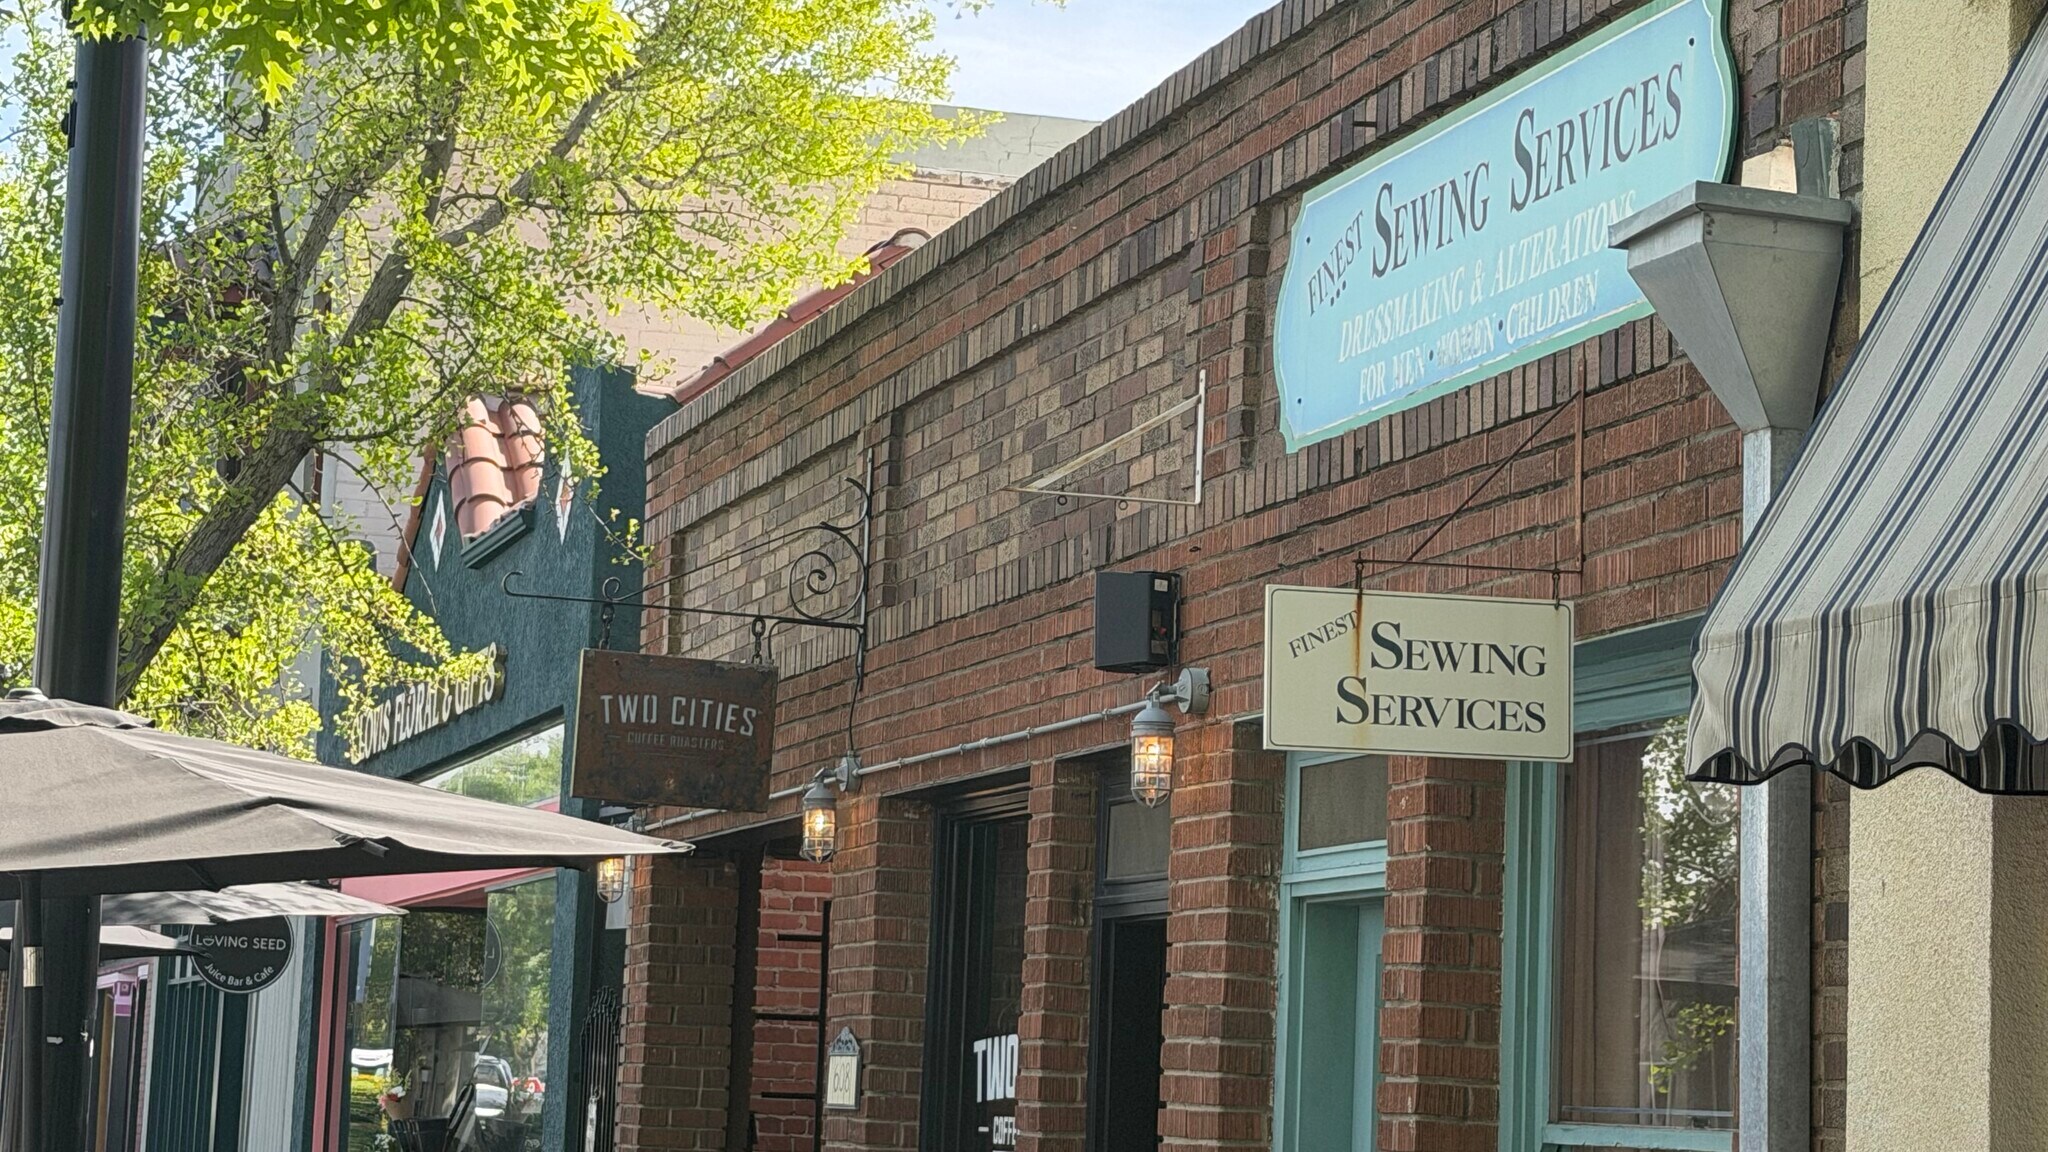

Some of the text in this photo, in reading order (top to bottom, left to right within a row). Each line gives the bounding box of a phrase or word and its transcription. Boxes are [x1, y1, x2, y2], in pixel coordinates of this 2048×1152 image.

[1371, 62, 1684, 280] SEWING SERVICES
[1306, 209, 1366, 317] FINEST
[1338, 267, 1466, 363] DRESSMAKING
[1470, 258, 1486, 305] &
[1359, 361, 1387, 405] FOR
[1391, 342, 1427, 392] MEN
[1505, 269, 1600, 345] CHILDREN
[1288, 609, 1360, 660] FINEST
[1370, 620, 1547, 678] SEWING
[393, 678, 440, 745] FLORAL
[600, 694, 757, 737] TWO CITIES
[1336, 675, 1547, 734] SERVICES
[252, 937, 287, 951] SEED
[204, 963, 275, 987] Juice Bar & Cafe
[833, 1062, 850, 1093] 608
[973, 1034, 1018, 1103] TWO
